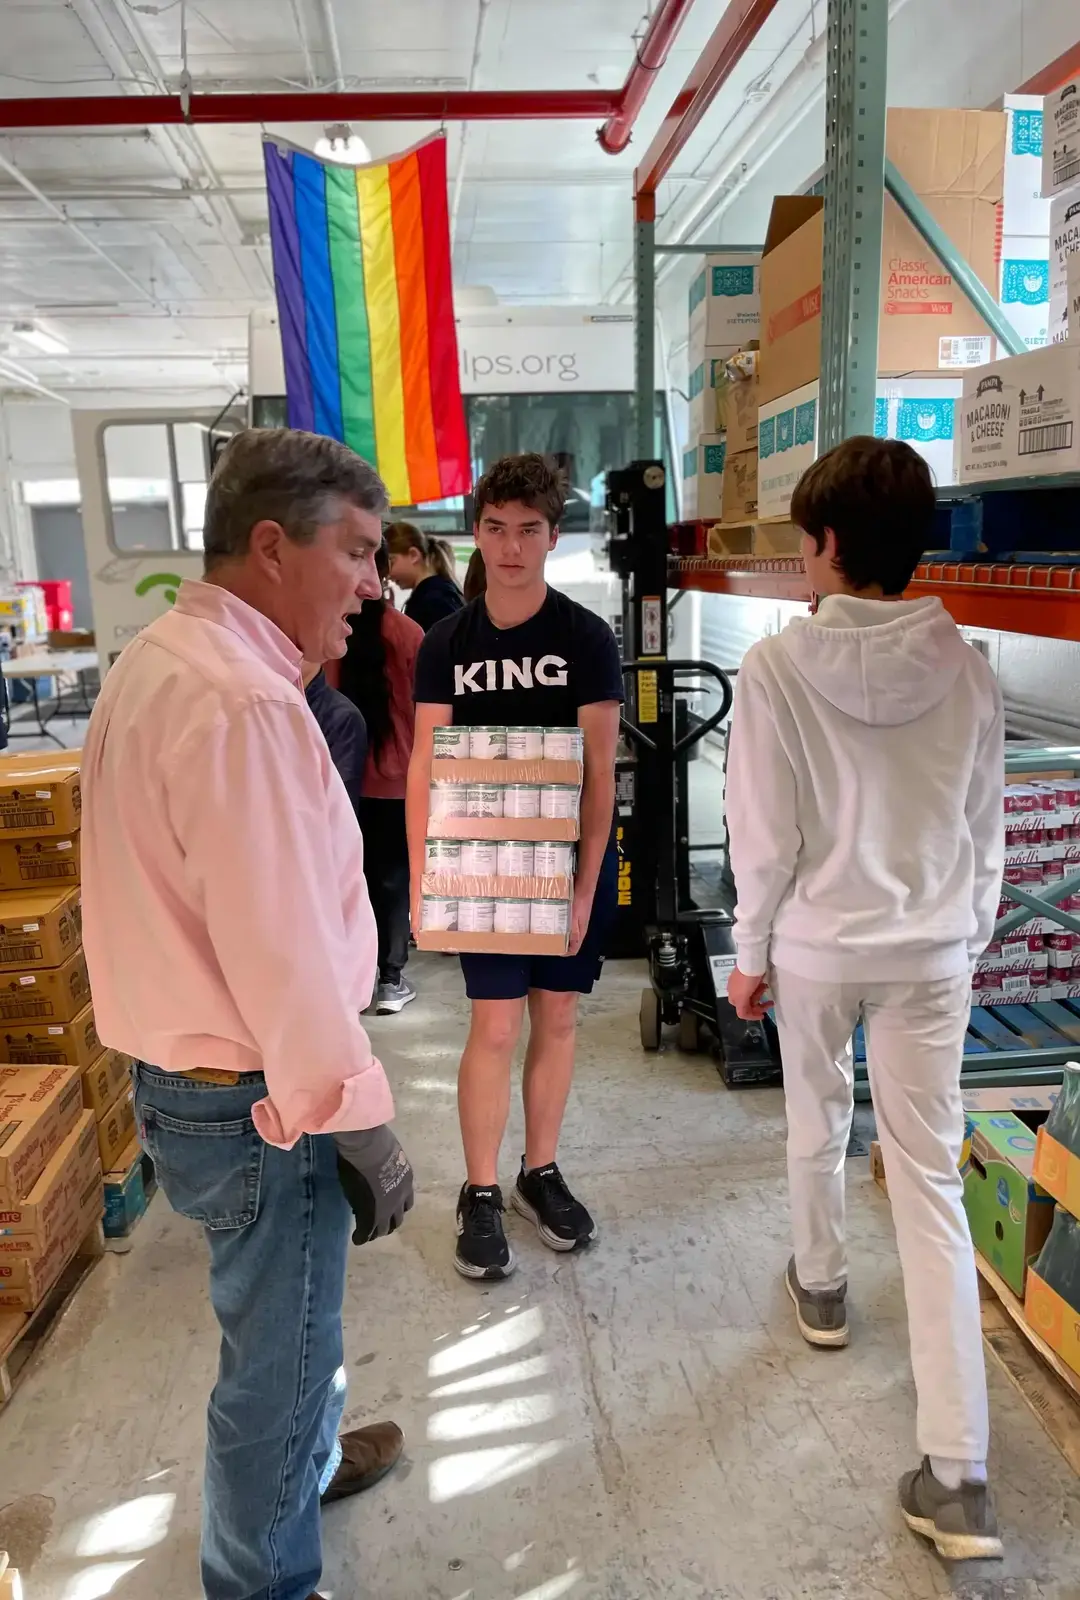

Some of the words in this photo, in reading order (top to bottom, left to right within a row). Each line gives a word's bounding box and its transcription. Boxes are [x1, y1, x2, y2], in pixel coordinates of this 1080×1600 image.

[888, 258, 930, 272] Classic
[888, 273, 952, 286] American
[887, 286, 930, 299] Snacks
[966, 403, 1011, 428] MACARONI
[970, 431, 975, 443] &
[976, 420, 1006, 440] CHEESE
[453, 654, 569, 696] KING
